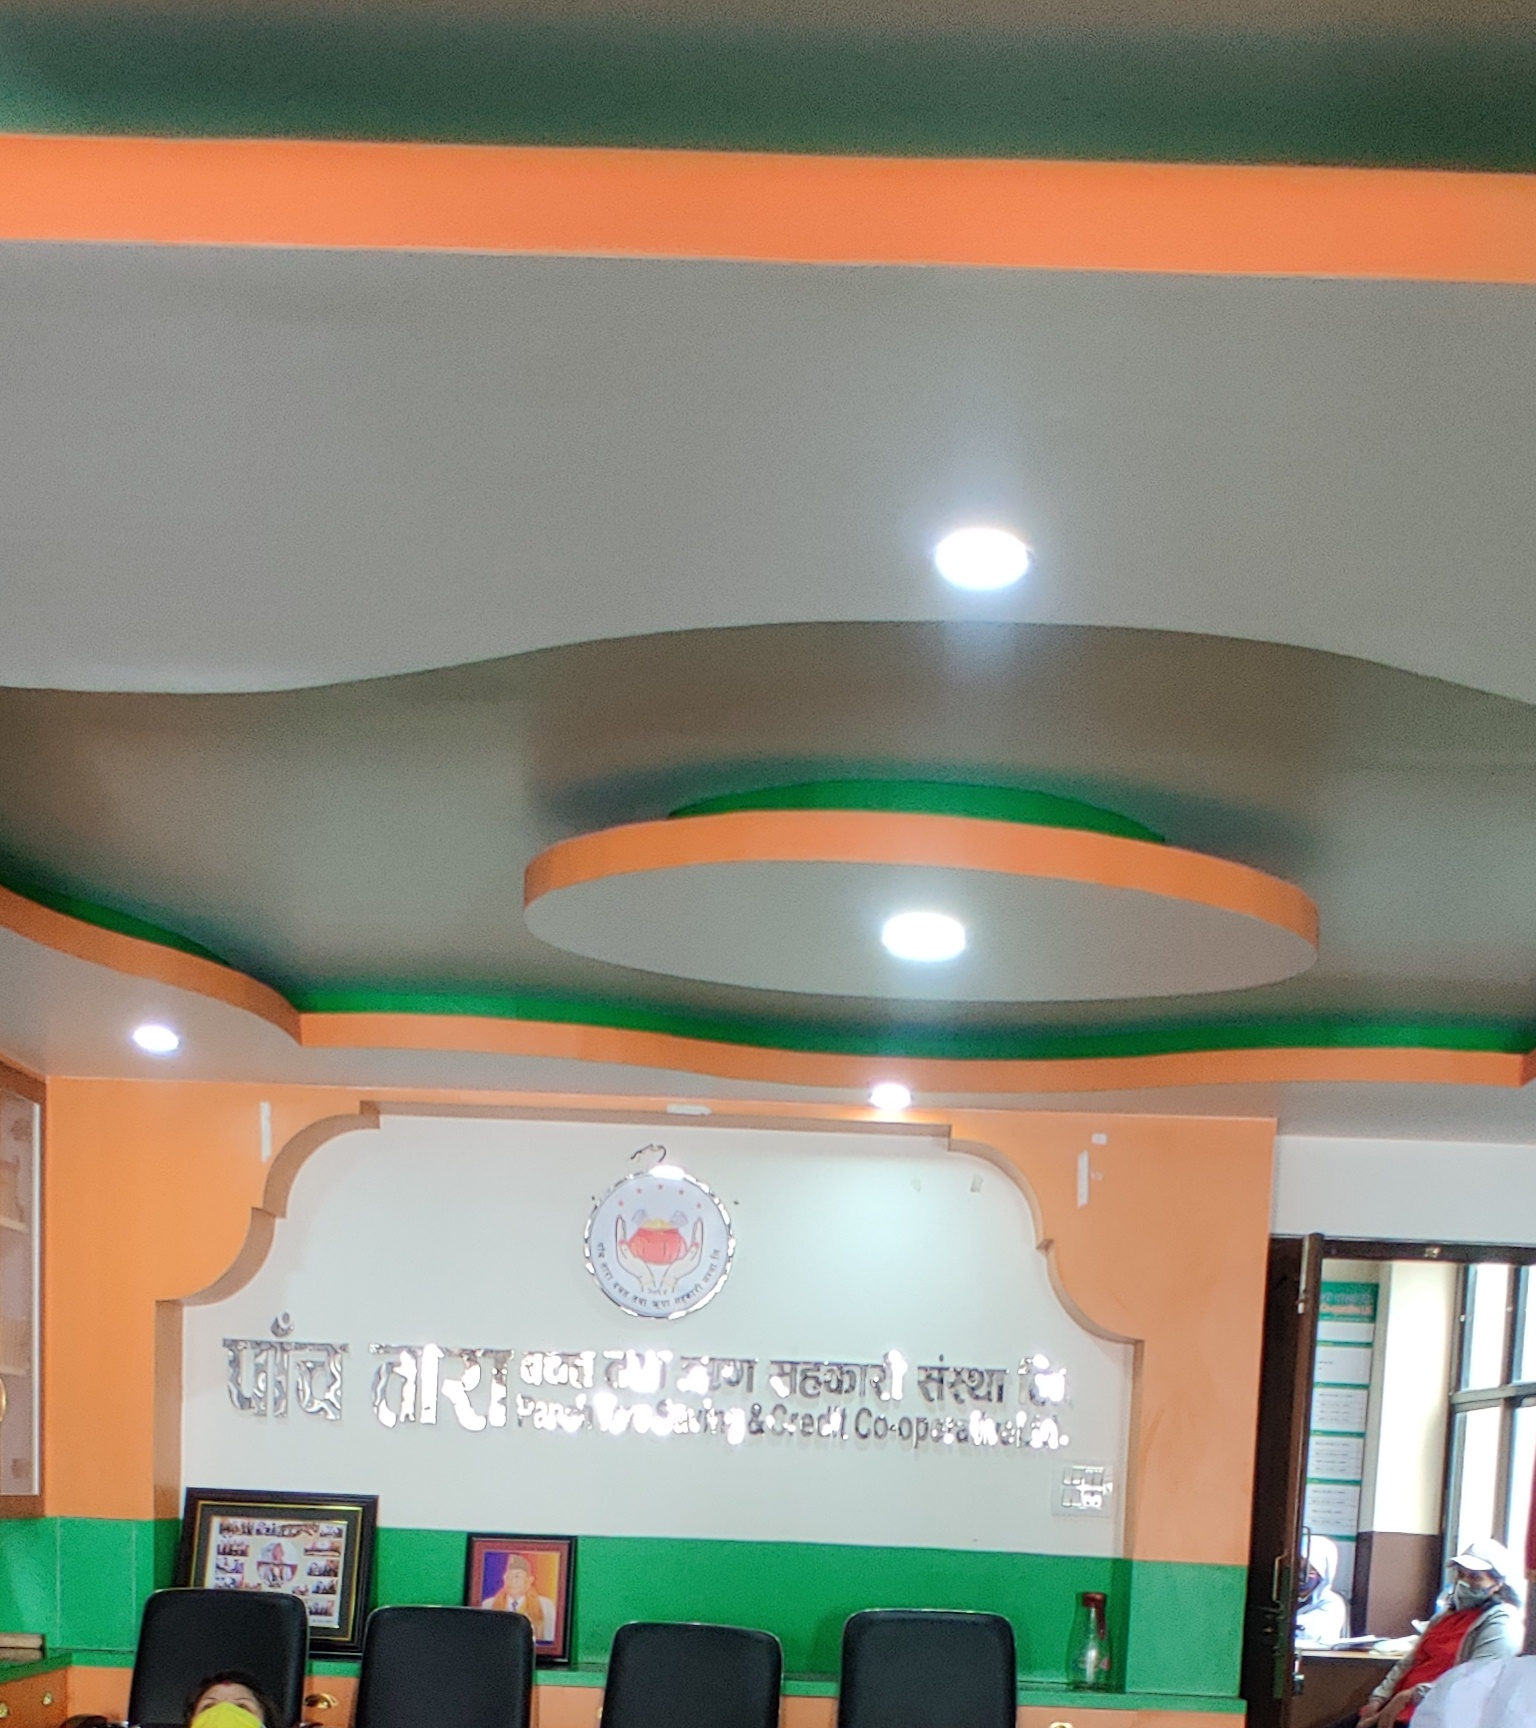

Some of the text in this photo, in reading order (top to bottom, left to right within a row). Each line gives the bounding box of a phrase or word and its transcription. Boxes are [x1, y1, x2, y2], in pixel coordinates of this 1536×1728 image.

[221, 1311, 350, 1422] पाँच
[367, 1342, 514, 1432] तारा
[519, 1350, 597, 1388] बचत
[769, 1349, 908, 1401] सहकारी
[917, 1354, 1009, 1405] संस्था
[748, 1403, 765, 1435] &
[765, 1404, 849, 1440] Credit
